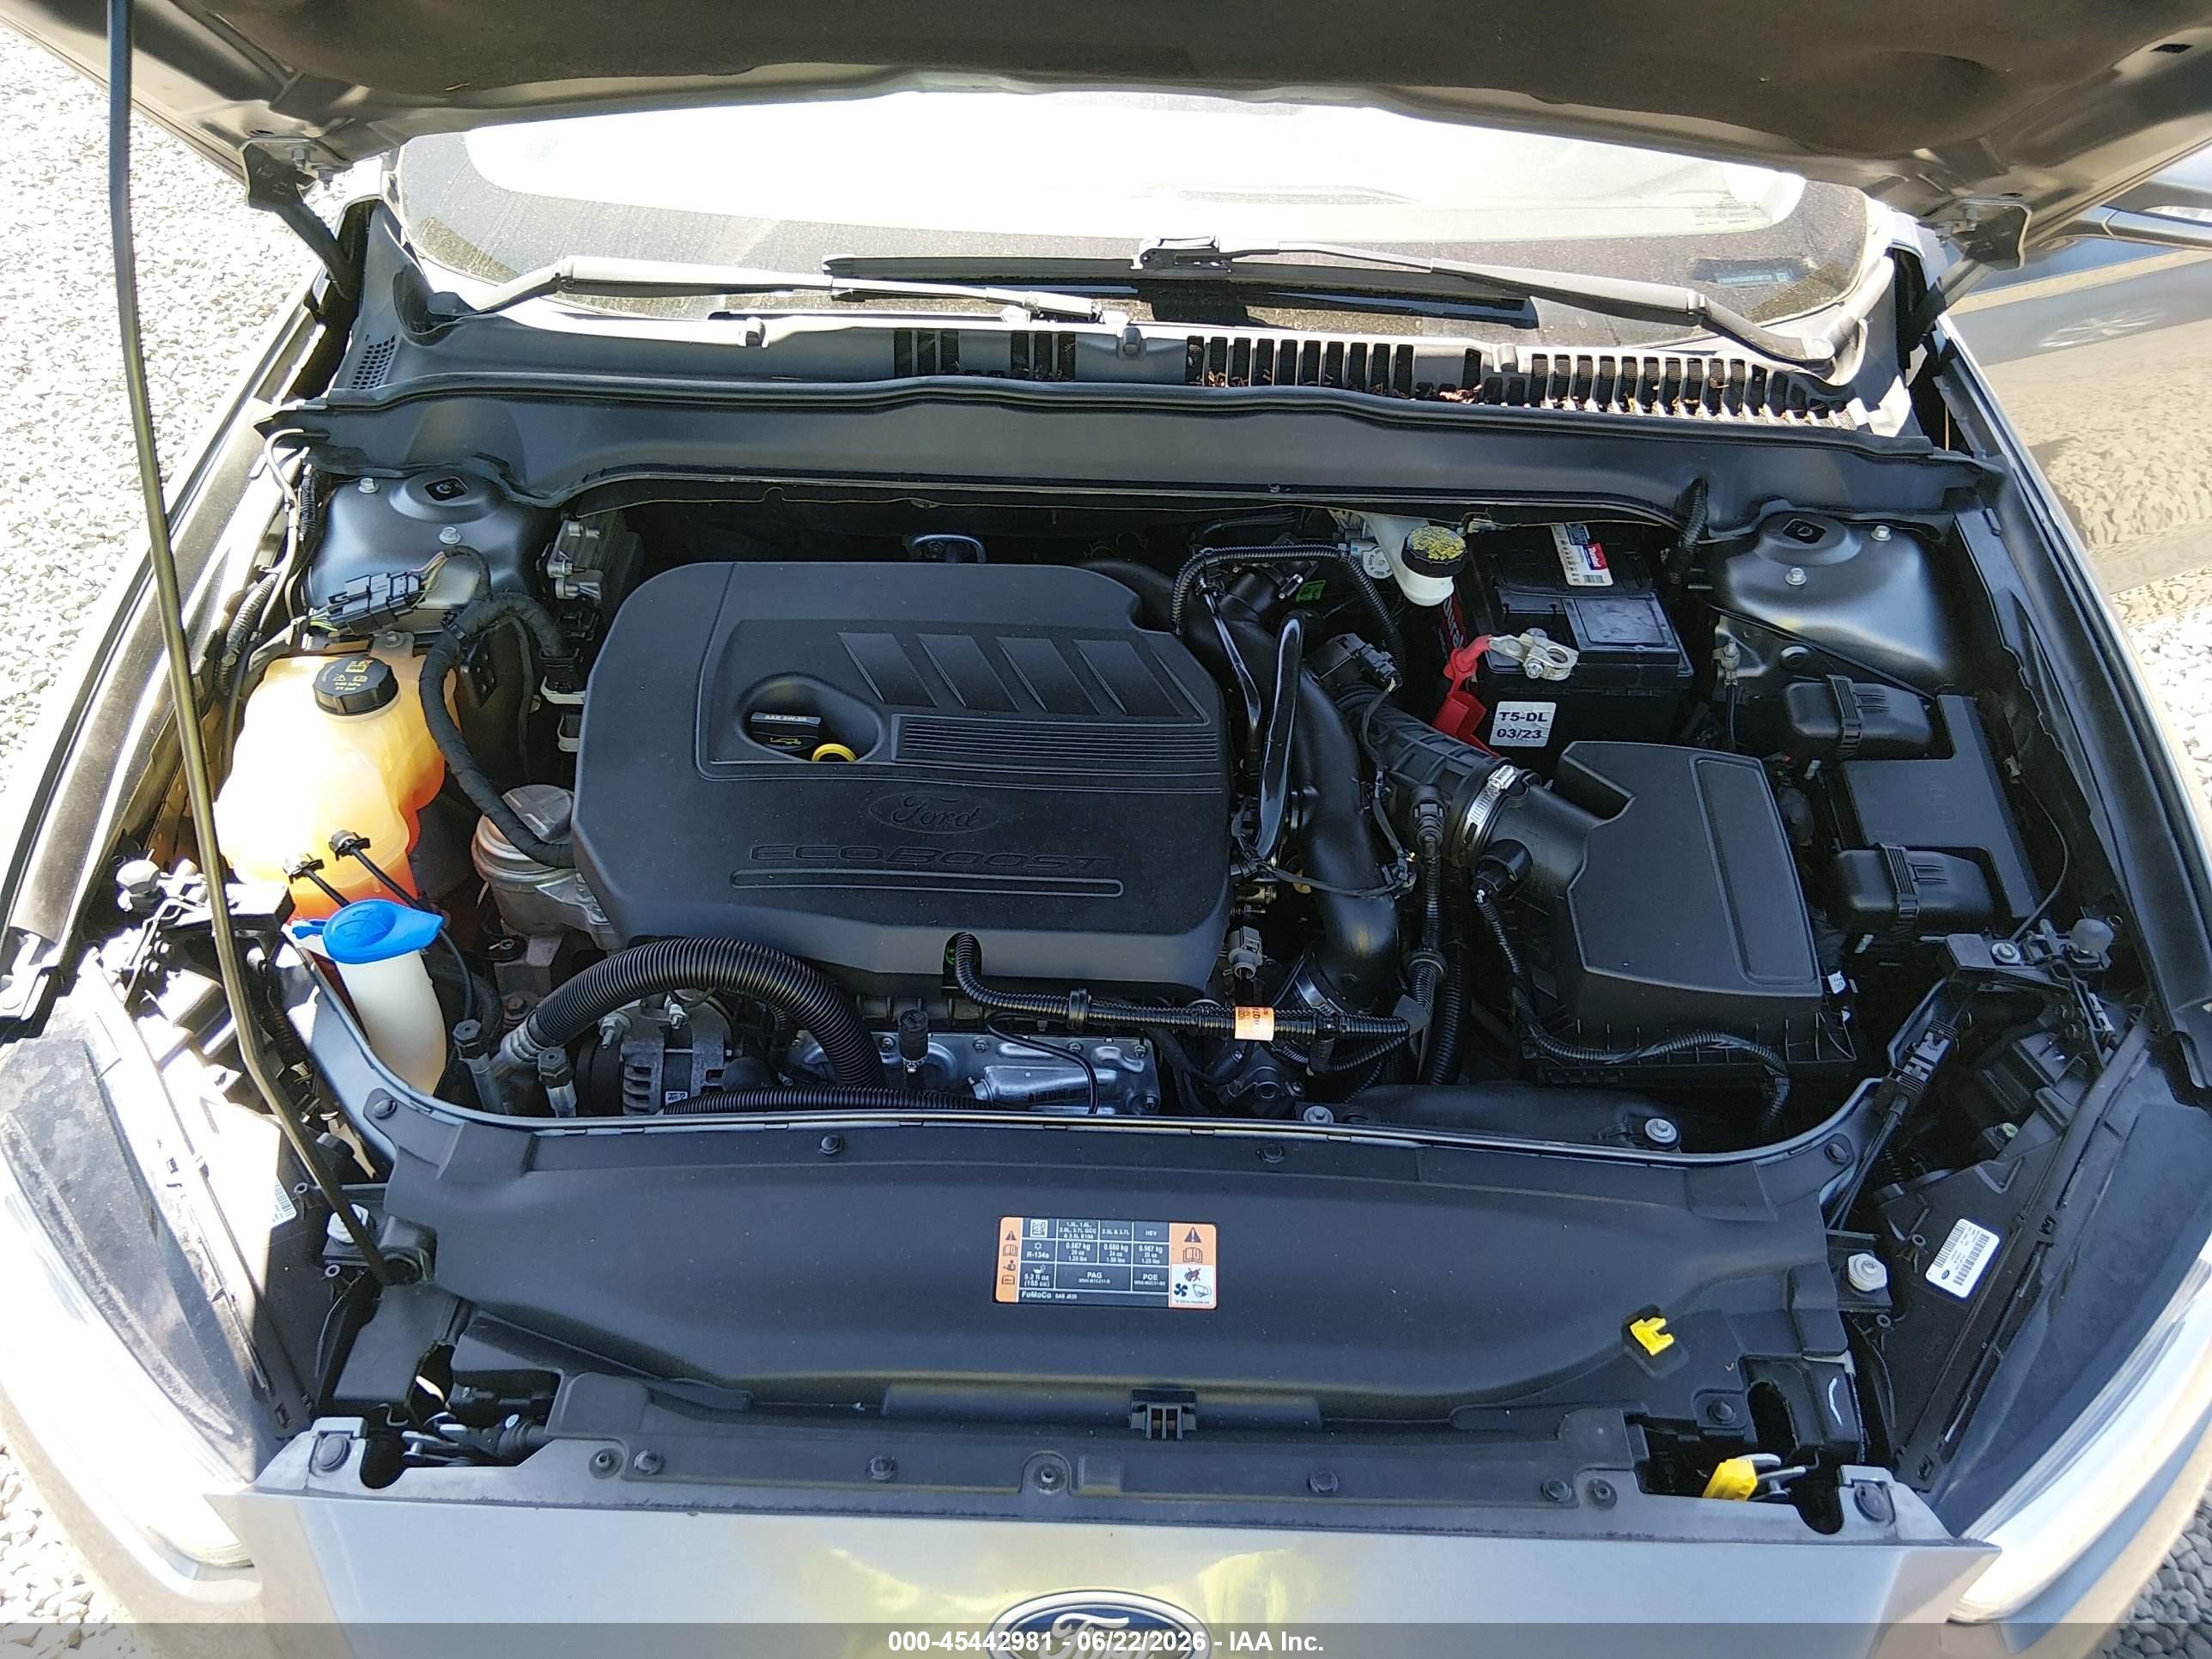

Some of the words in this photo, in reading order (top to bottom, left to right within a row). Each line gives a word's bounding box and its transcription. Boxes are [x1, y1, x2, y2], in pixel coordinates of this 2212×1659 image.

[1498, 711, 1547, 722] T5-DL
[1496, 728, 1542, 739] 03/23
[891, 795, 982, 828] Ford
[1083, 1243, 1091, 1251] kg
[1121, 1243, 1128, 1253] kg
[1026, 1250, 1049, 1259] R-134a
[1021, 1291, 1052, 1299] FoMoCo
